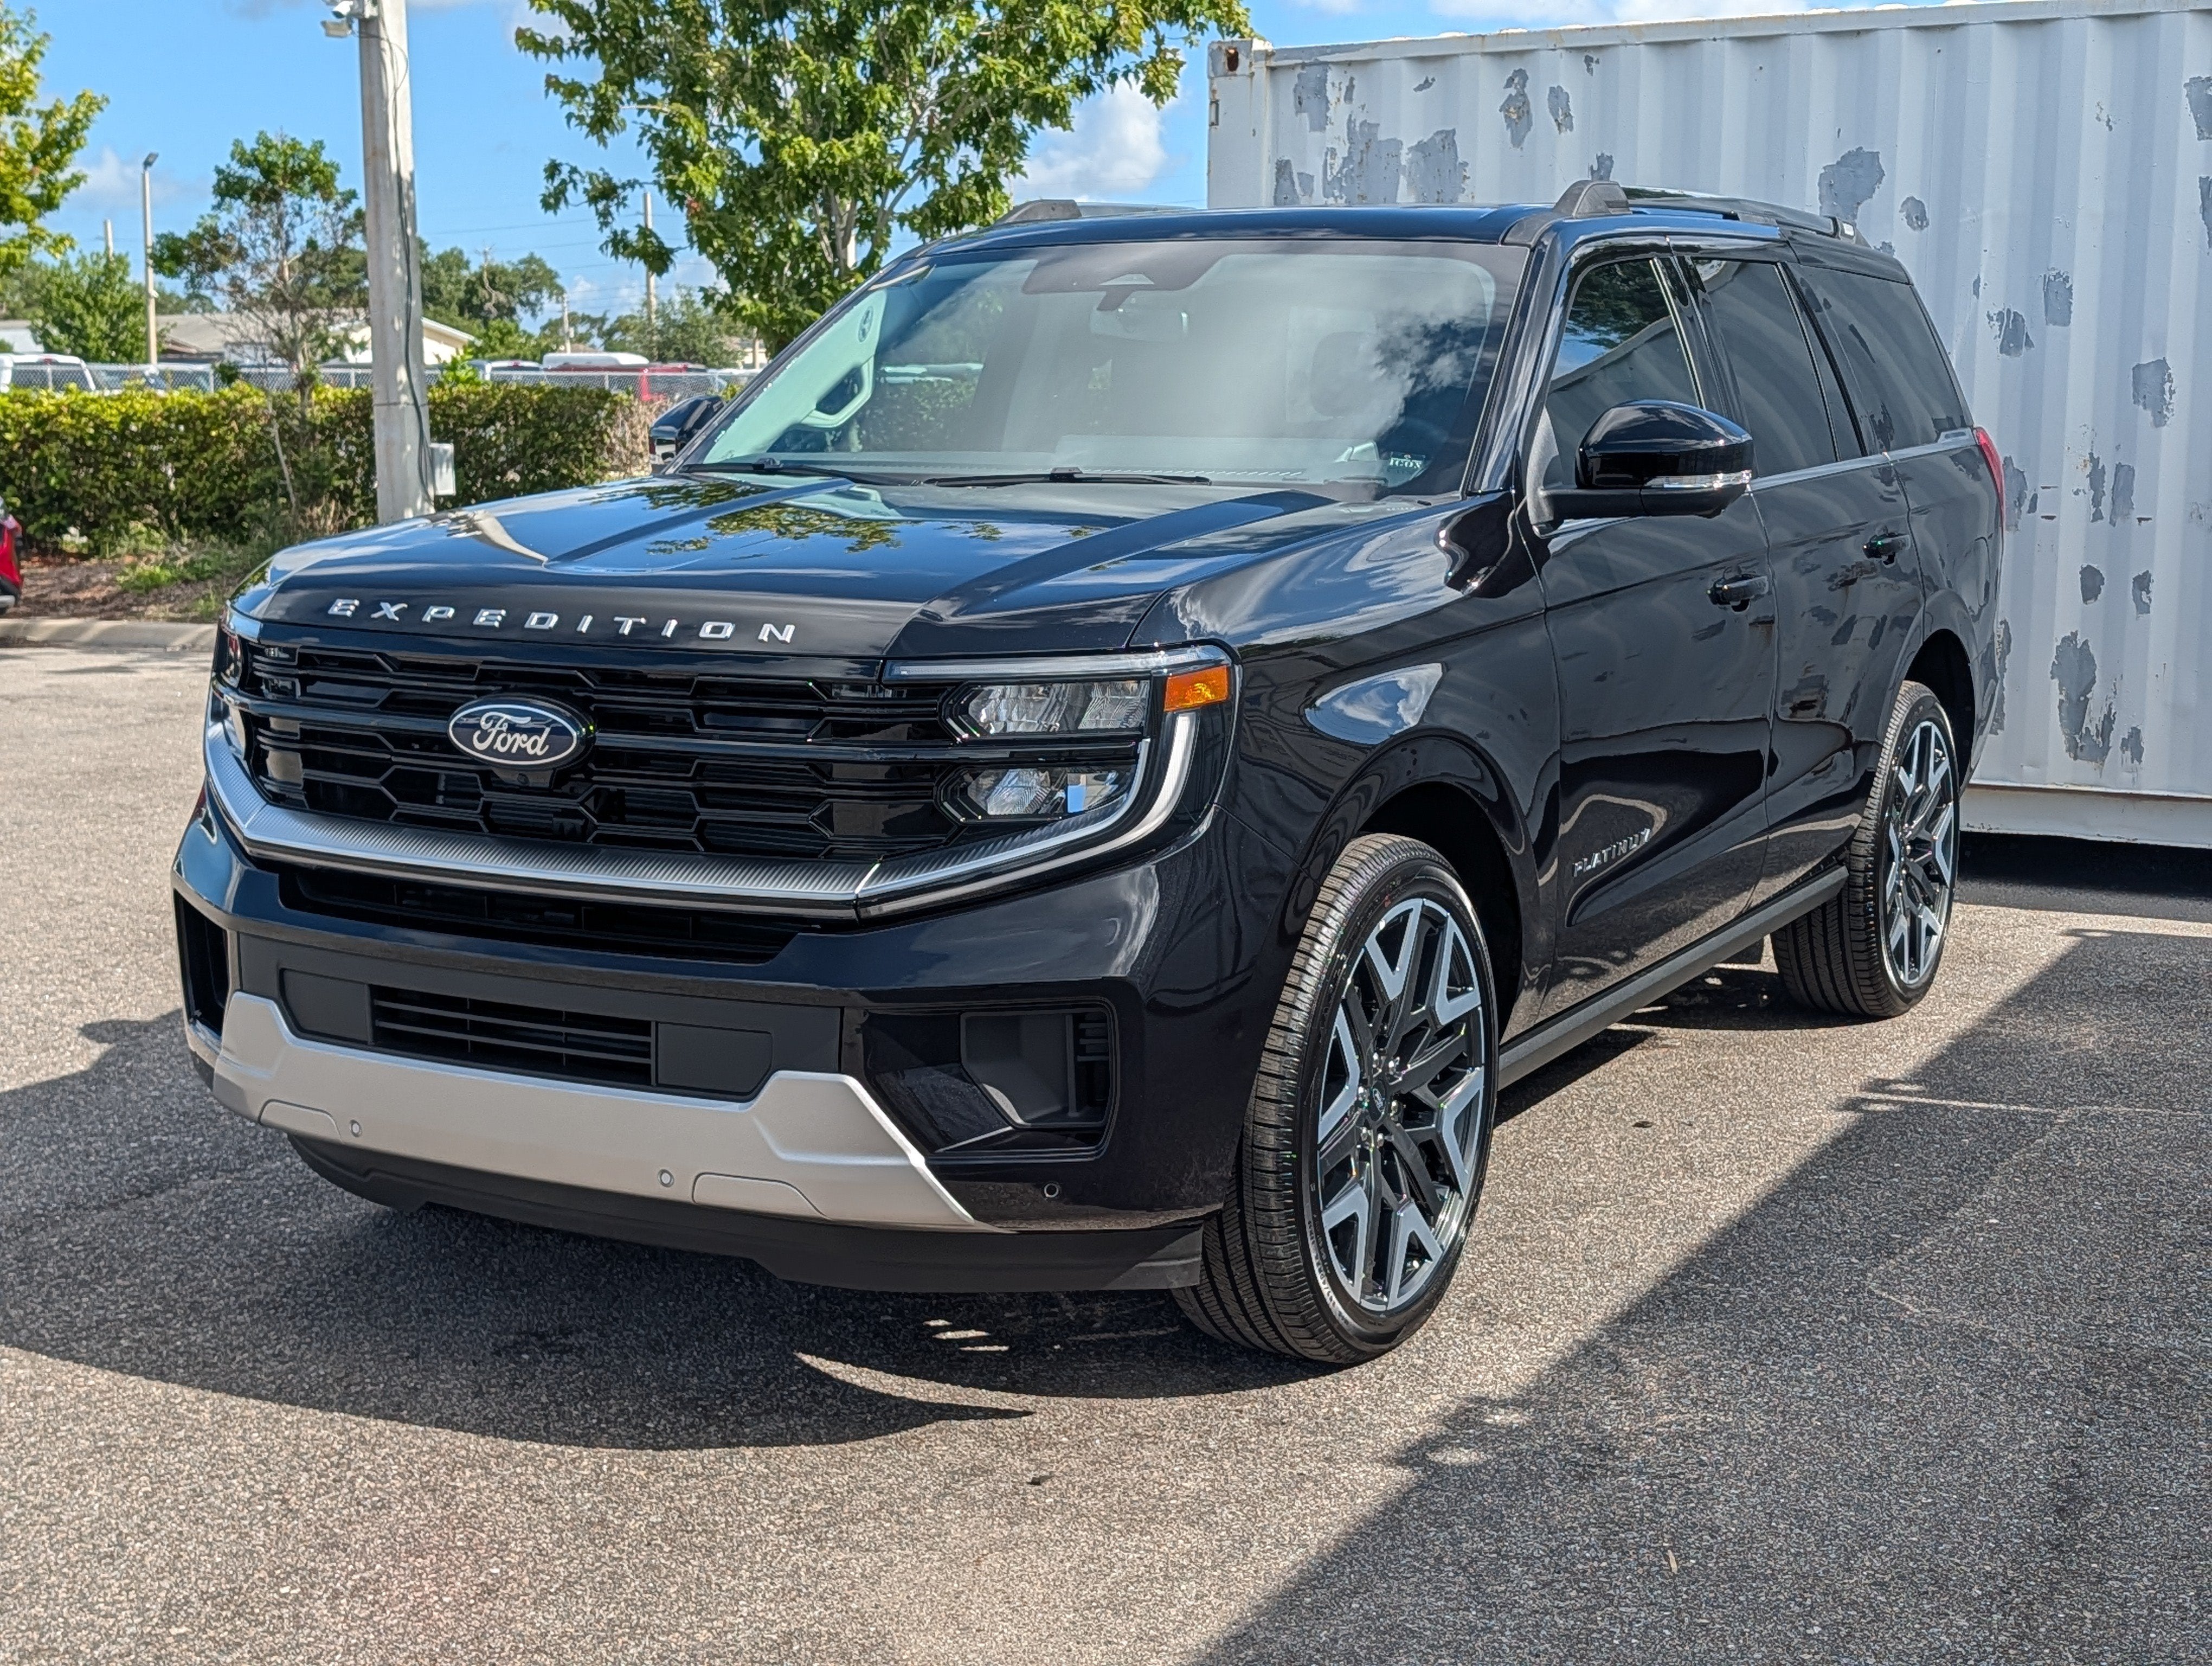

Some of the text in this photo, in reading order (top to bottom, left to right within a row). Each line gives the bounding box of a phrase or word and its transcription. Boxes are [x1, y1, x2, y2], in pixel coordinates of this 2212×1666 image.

[327, 598, 796, 644] EXPEDITION
[472, 711, 552, 756] Ford
[1573, 828, 1650, 877] PLATINUM
